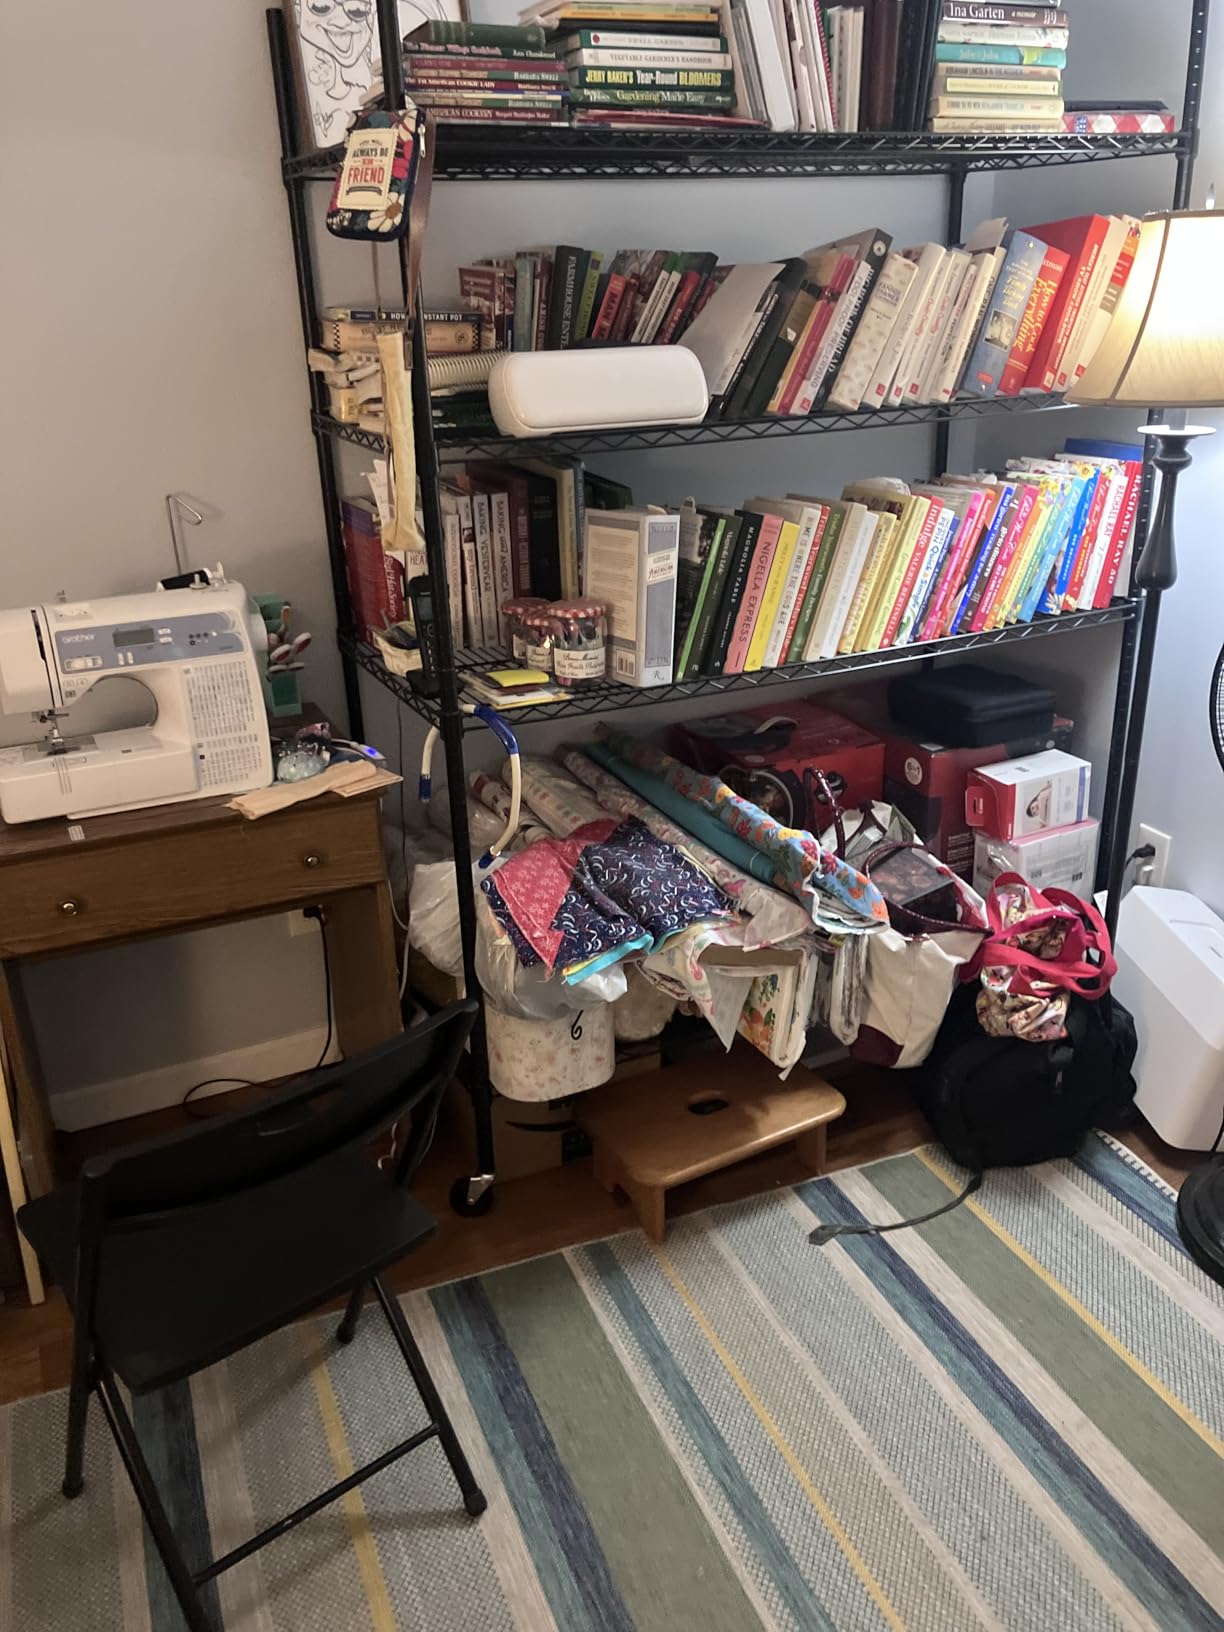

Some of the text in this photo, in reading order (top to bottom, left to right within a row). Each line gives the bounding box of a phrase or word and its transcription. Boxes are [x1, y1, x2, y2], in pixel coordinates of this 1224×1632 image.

[950, 5, 1004, 19] Ina Garten
[661, 91, 686, 101] Made
[686, 92, 706, 104] Easy
[679, 72, 721, 87] BLOOMERS
[352, 147, 378, 158] ALWAYS
[347, 166, 385, 185] FRIEND
[562, 256, 577, 317] FARMHOUSE
[424, 312, 448, 321] NSTANT
[449, 313, 462, 321] POT
[1012, 276, 1048, 352] Everything
[825, 333, 849, 374] BREAD
[1023, 321, 1044, 354] Cook
[809, 330, 841, 389] PRESERVING
[494, 499, 506, 534] BAKING
[1102, 483, 1125, 538] RACHAEL RAY
[1117, 473, 1144, 538] RACHAEL
[477, 501, 491, 592] BAKING YESTERYEAR
[737, 525, 755, 574] MAGNOLIA
[751, 539, 772, 593] NIGELLA
[1110, 538, 1125, 566] RAY
[465, 547, 477, 591] my bread
[497, 553, 509, 593] AMERICA
[886, 502, 941, 634] indulge VALERIE BERTINELLI
[909, 543, 939, 611] Quick Simple
[387, 593, 398, 618] Society
[729, 575, 742, 604] TABLE
[738, 594, 757, 644] EXPRESS
